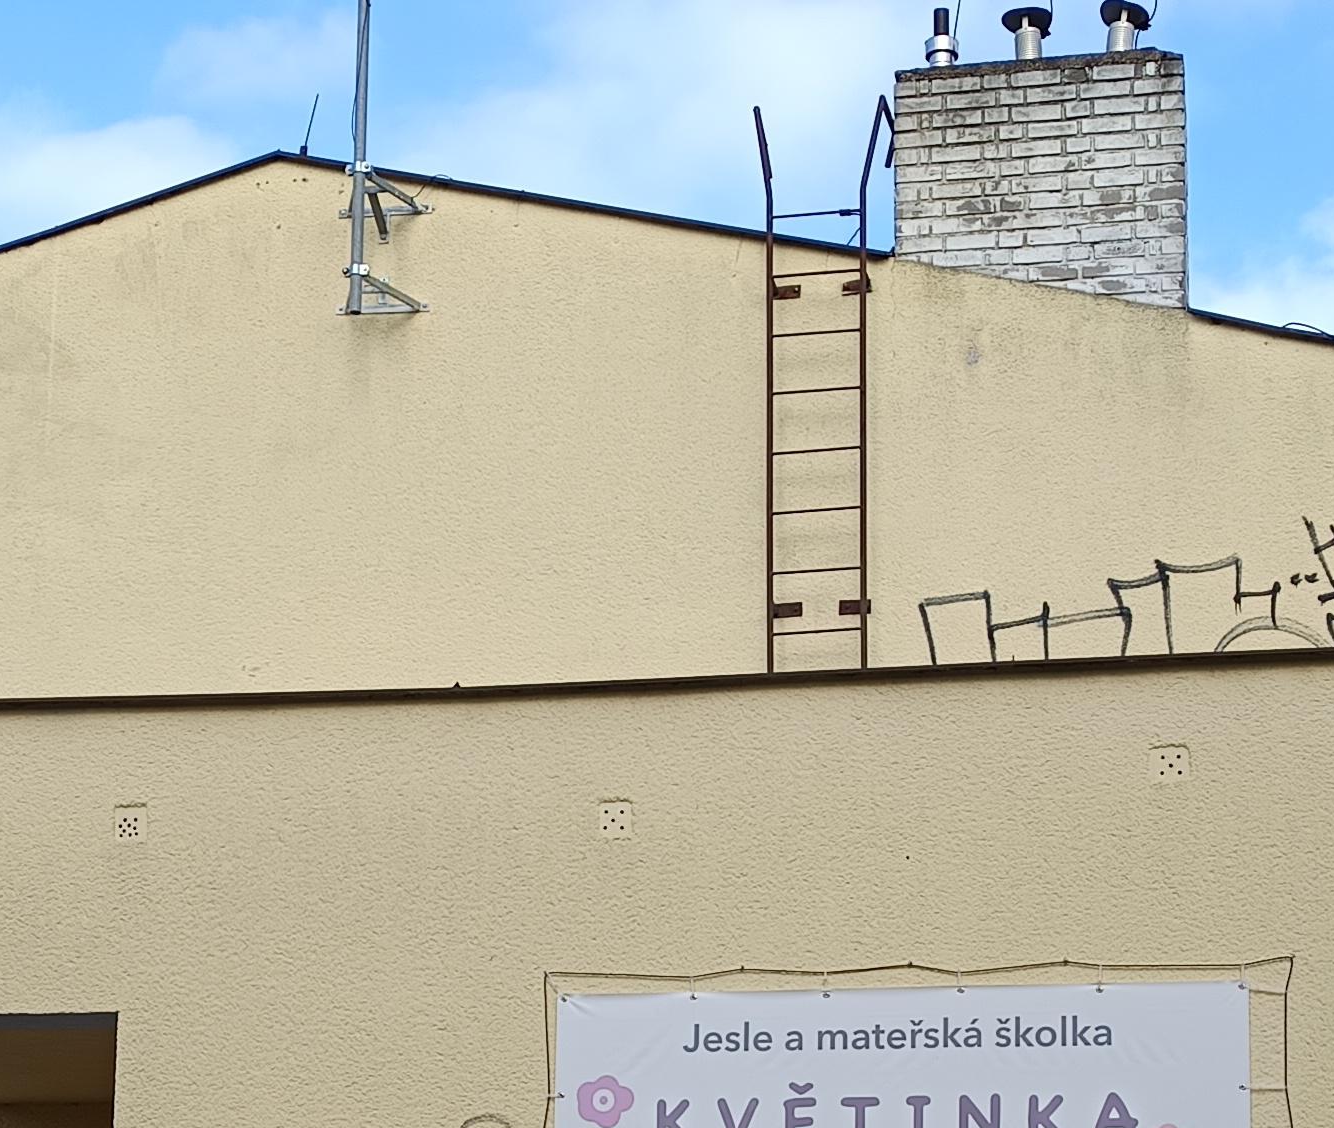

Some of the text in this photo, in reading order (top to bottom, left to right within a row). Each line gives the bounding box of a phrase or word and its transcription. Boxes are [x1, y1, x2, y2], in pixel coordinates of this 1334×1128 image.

[683, 1014, 1114, 1053] Jesle a mateřská školka
